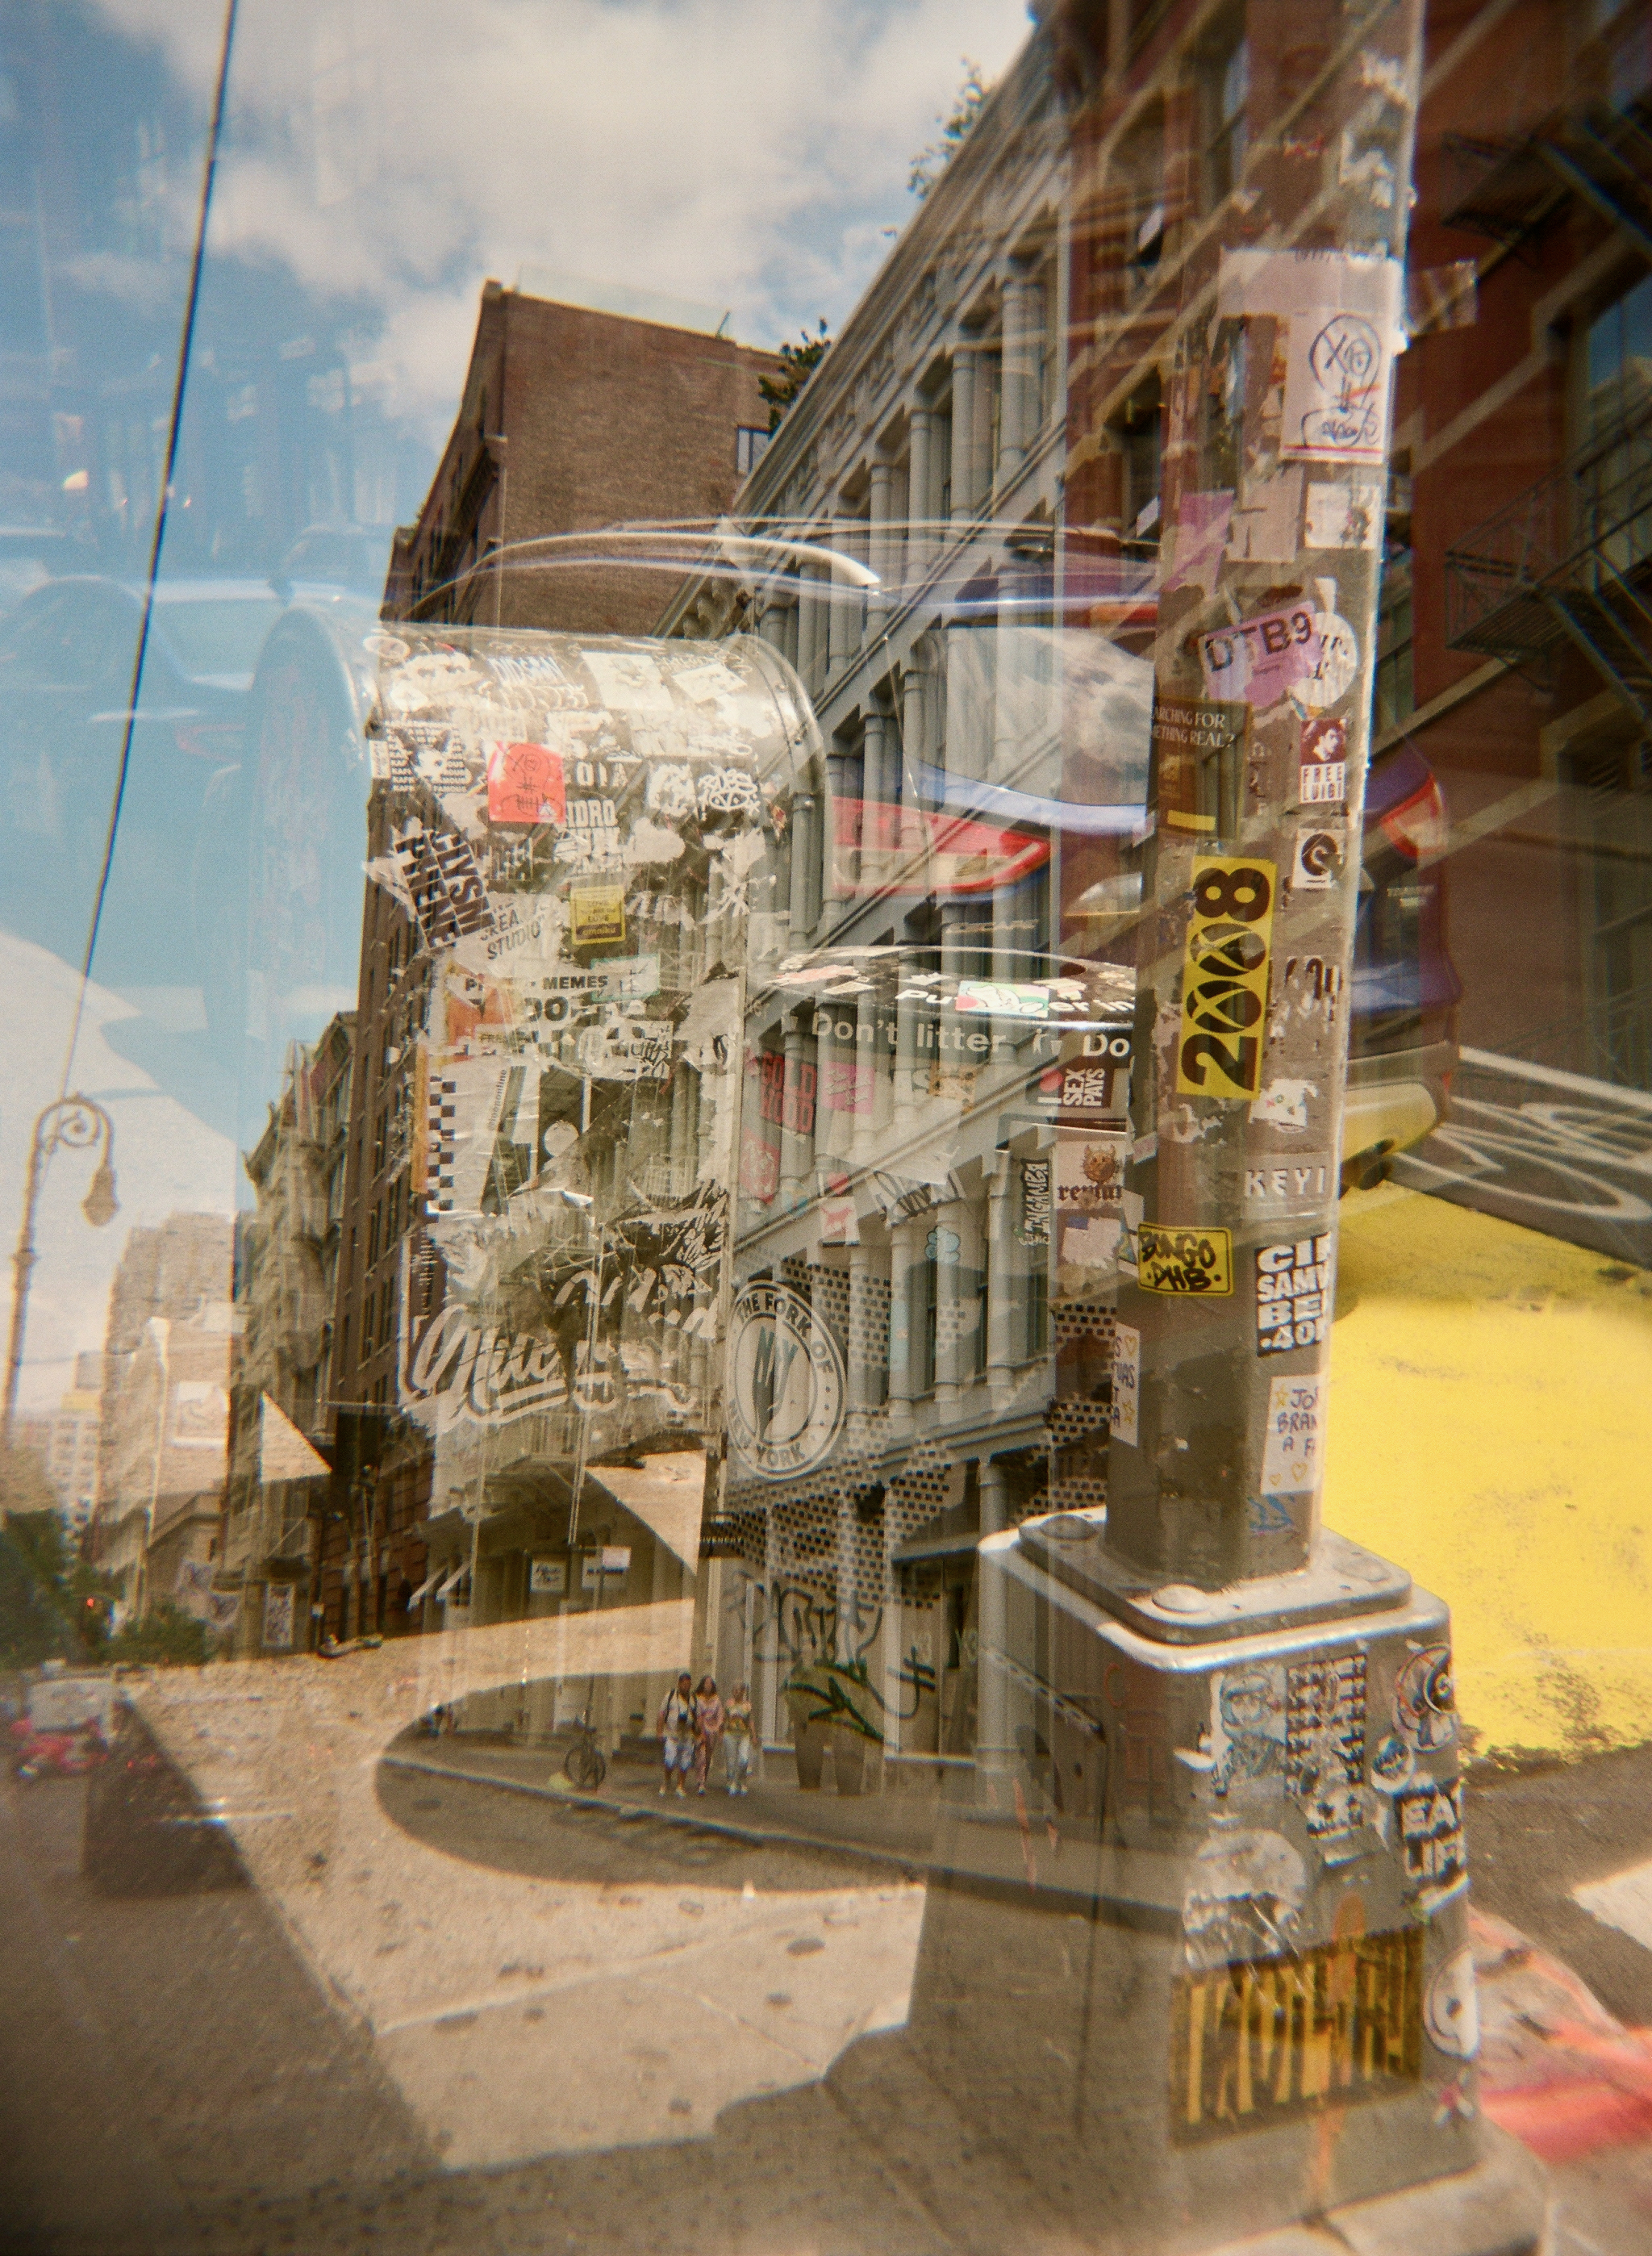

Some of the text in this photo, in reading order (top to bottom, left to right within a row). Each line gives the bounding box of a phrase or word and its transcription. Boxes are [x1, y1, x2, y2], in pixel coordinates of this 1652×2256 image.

[1195, 712, 1226, 729] FOR
[1303, 765, 1342, 784] FREE
[1303, 783, 1342, 801] LUIGI
[543, 975, 609, 990] MEMES
[811, 1013, 899, 1046] Don't
[916, 1022, 1007, 1055] litter
[761, 1051, 818, 1101] GOLD
[1063, 1068, 1086, 1107] SEX
[1083, 1068, 1106, 1107] PAYS
[736, 1292, 761, 1324] THE
[811, 1340, 834, 1374] OF
[755, 1441, 806, 1467] YORK
